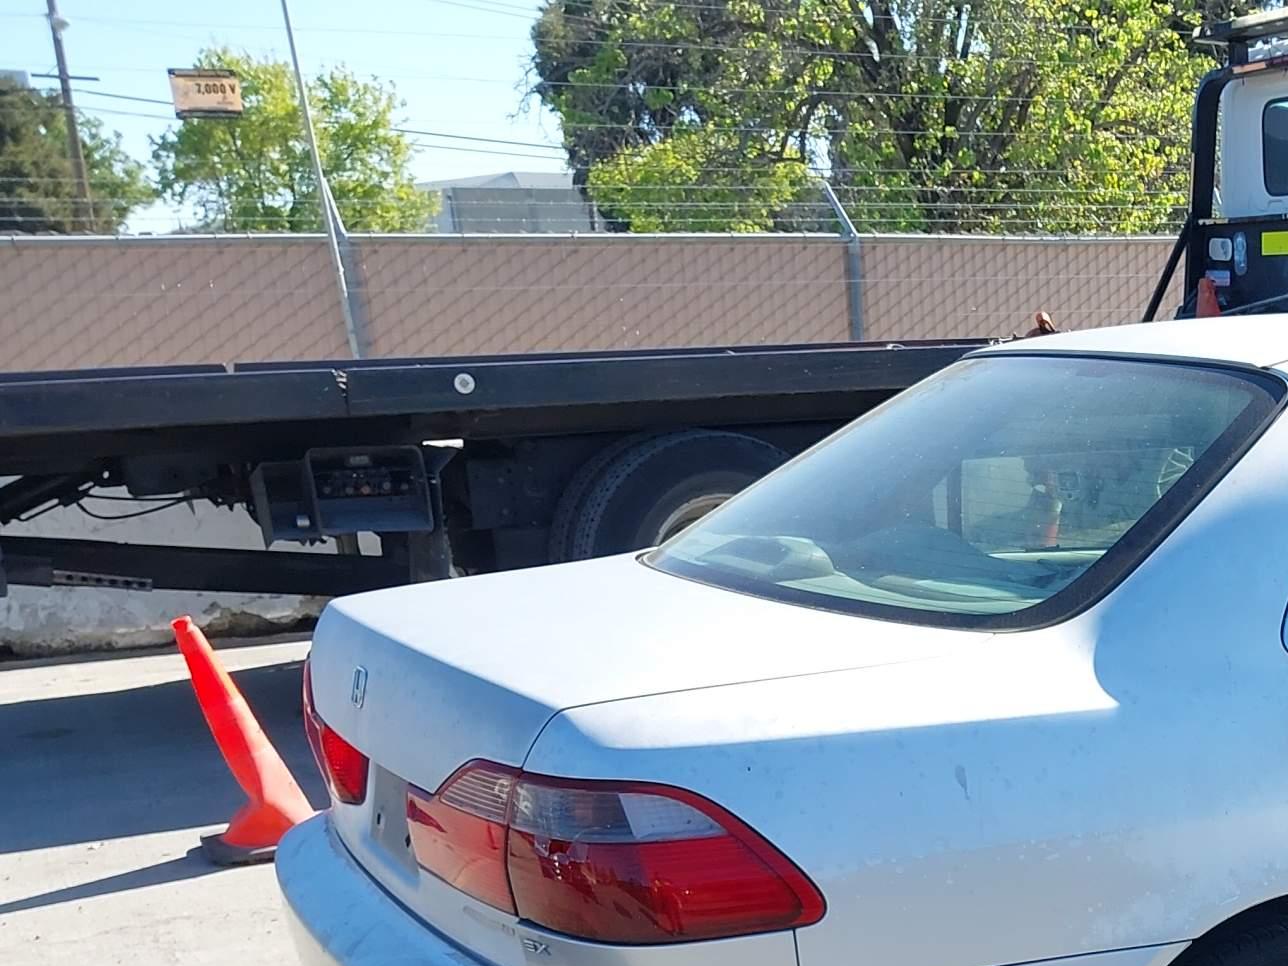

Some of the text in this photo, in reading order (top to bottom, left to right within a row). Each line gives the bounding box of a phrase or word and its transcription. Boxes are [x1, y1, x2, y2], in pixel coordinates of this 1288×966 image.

[194, 82, 236, 95] 7,000 V
[523, 938, 552, 956] EX
